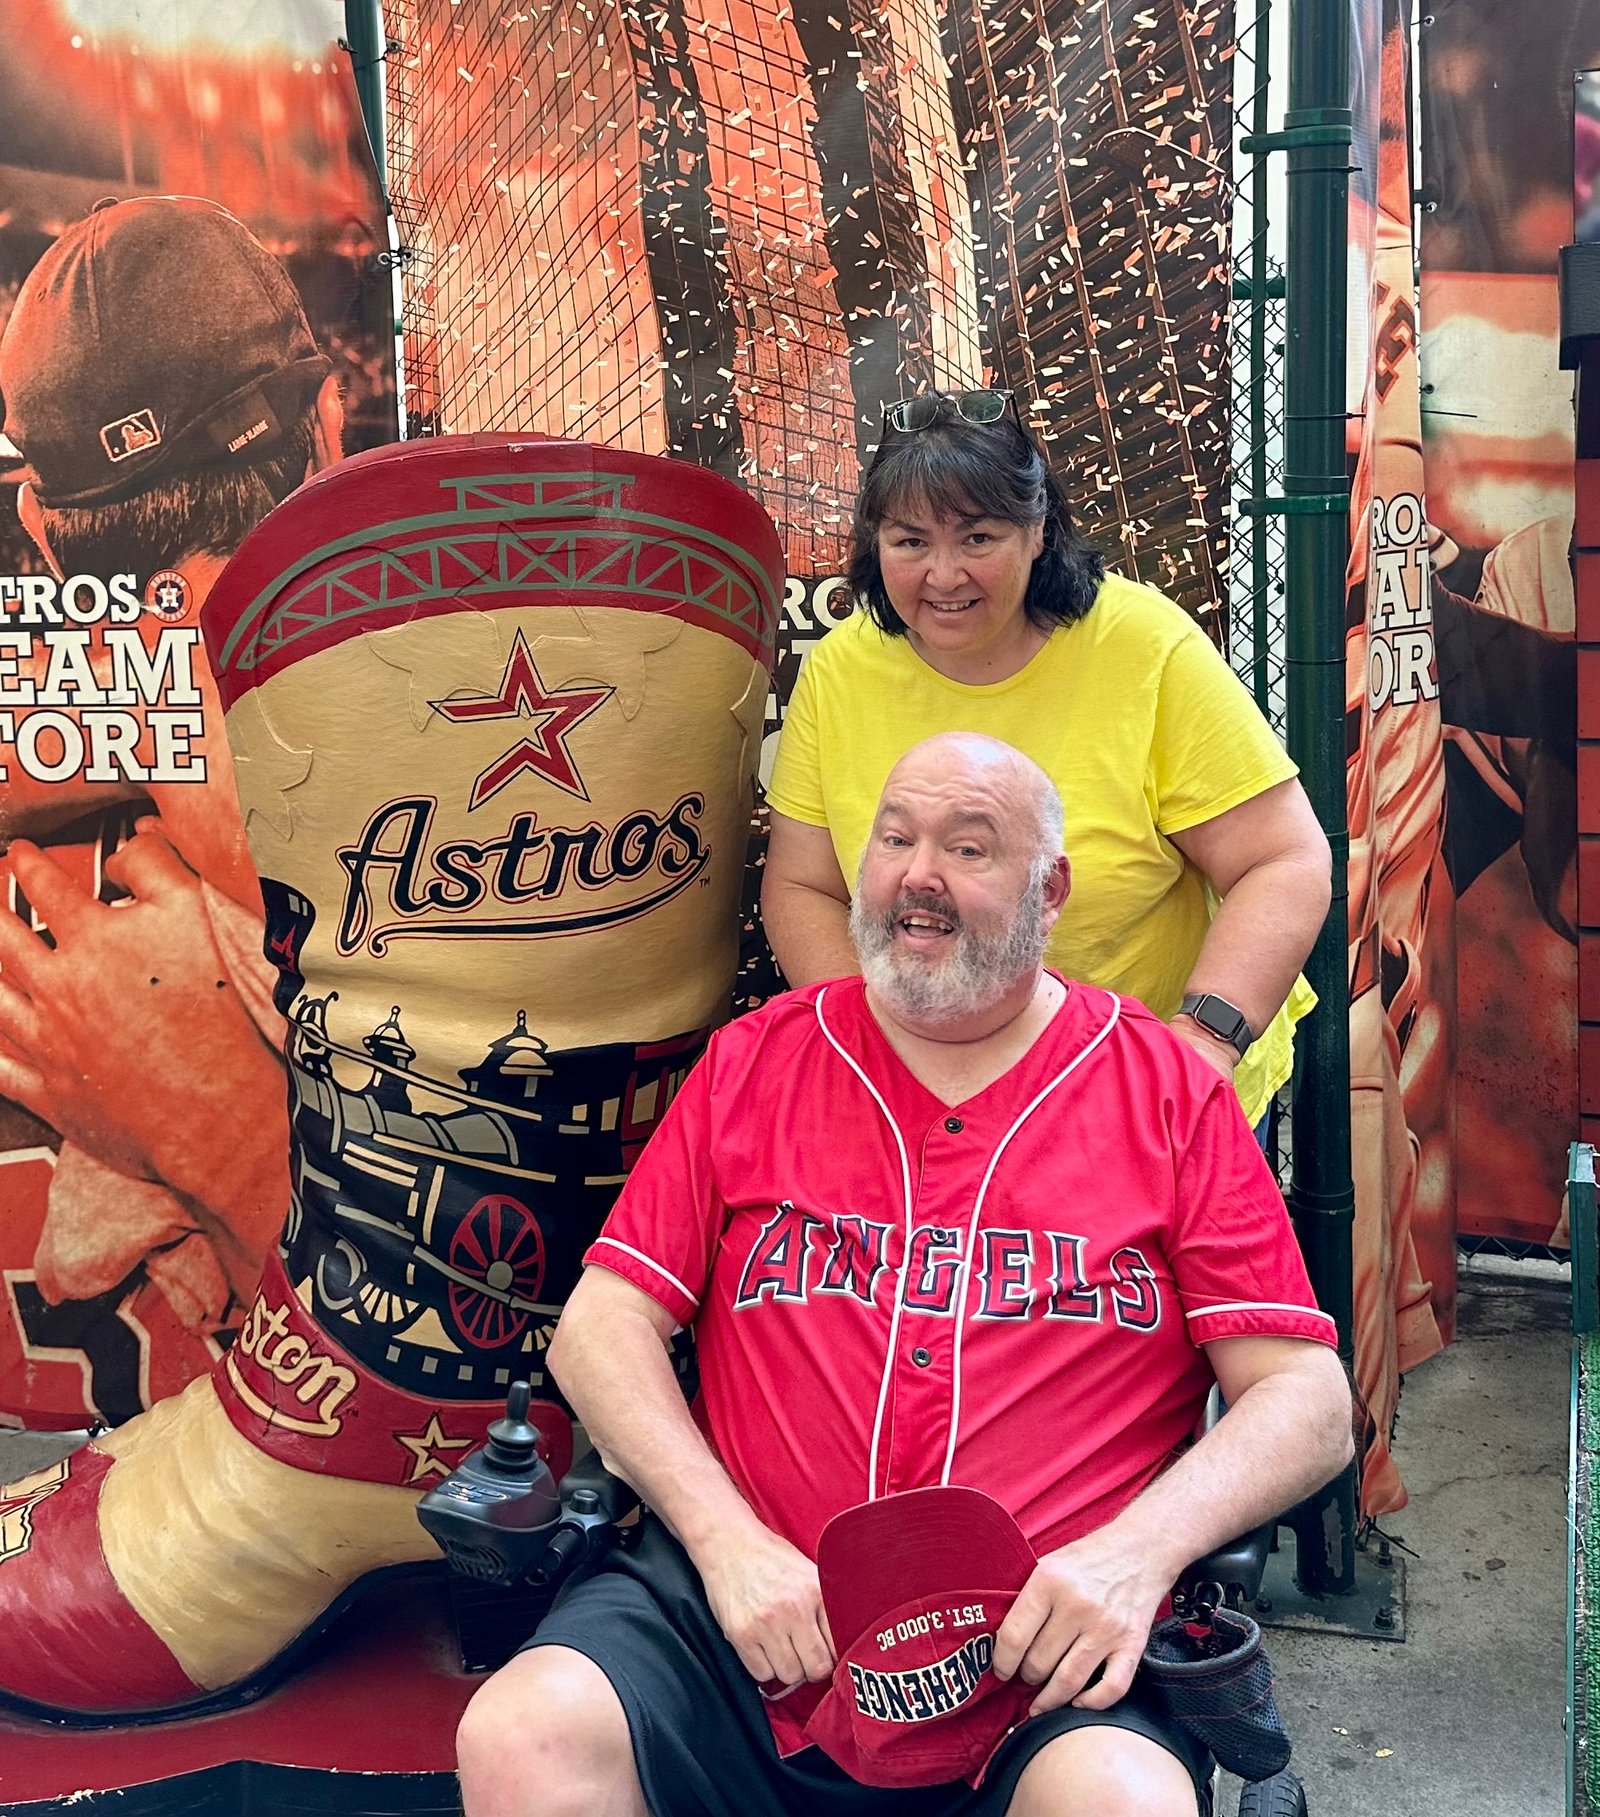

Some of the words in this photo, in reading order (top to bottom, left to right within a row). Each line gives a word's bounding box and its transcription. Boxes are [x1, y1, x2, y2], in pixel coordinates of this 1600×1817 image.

[336, 792, 711, 957] Astros
[733, 1201, 1162, 1334] ANGELS
[896, 1611, 945, 1643] 3,000
[947, 1604, 987, 1628] EST.
[876, 1627, 897, 1652] BC
